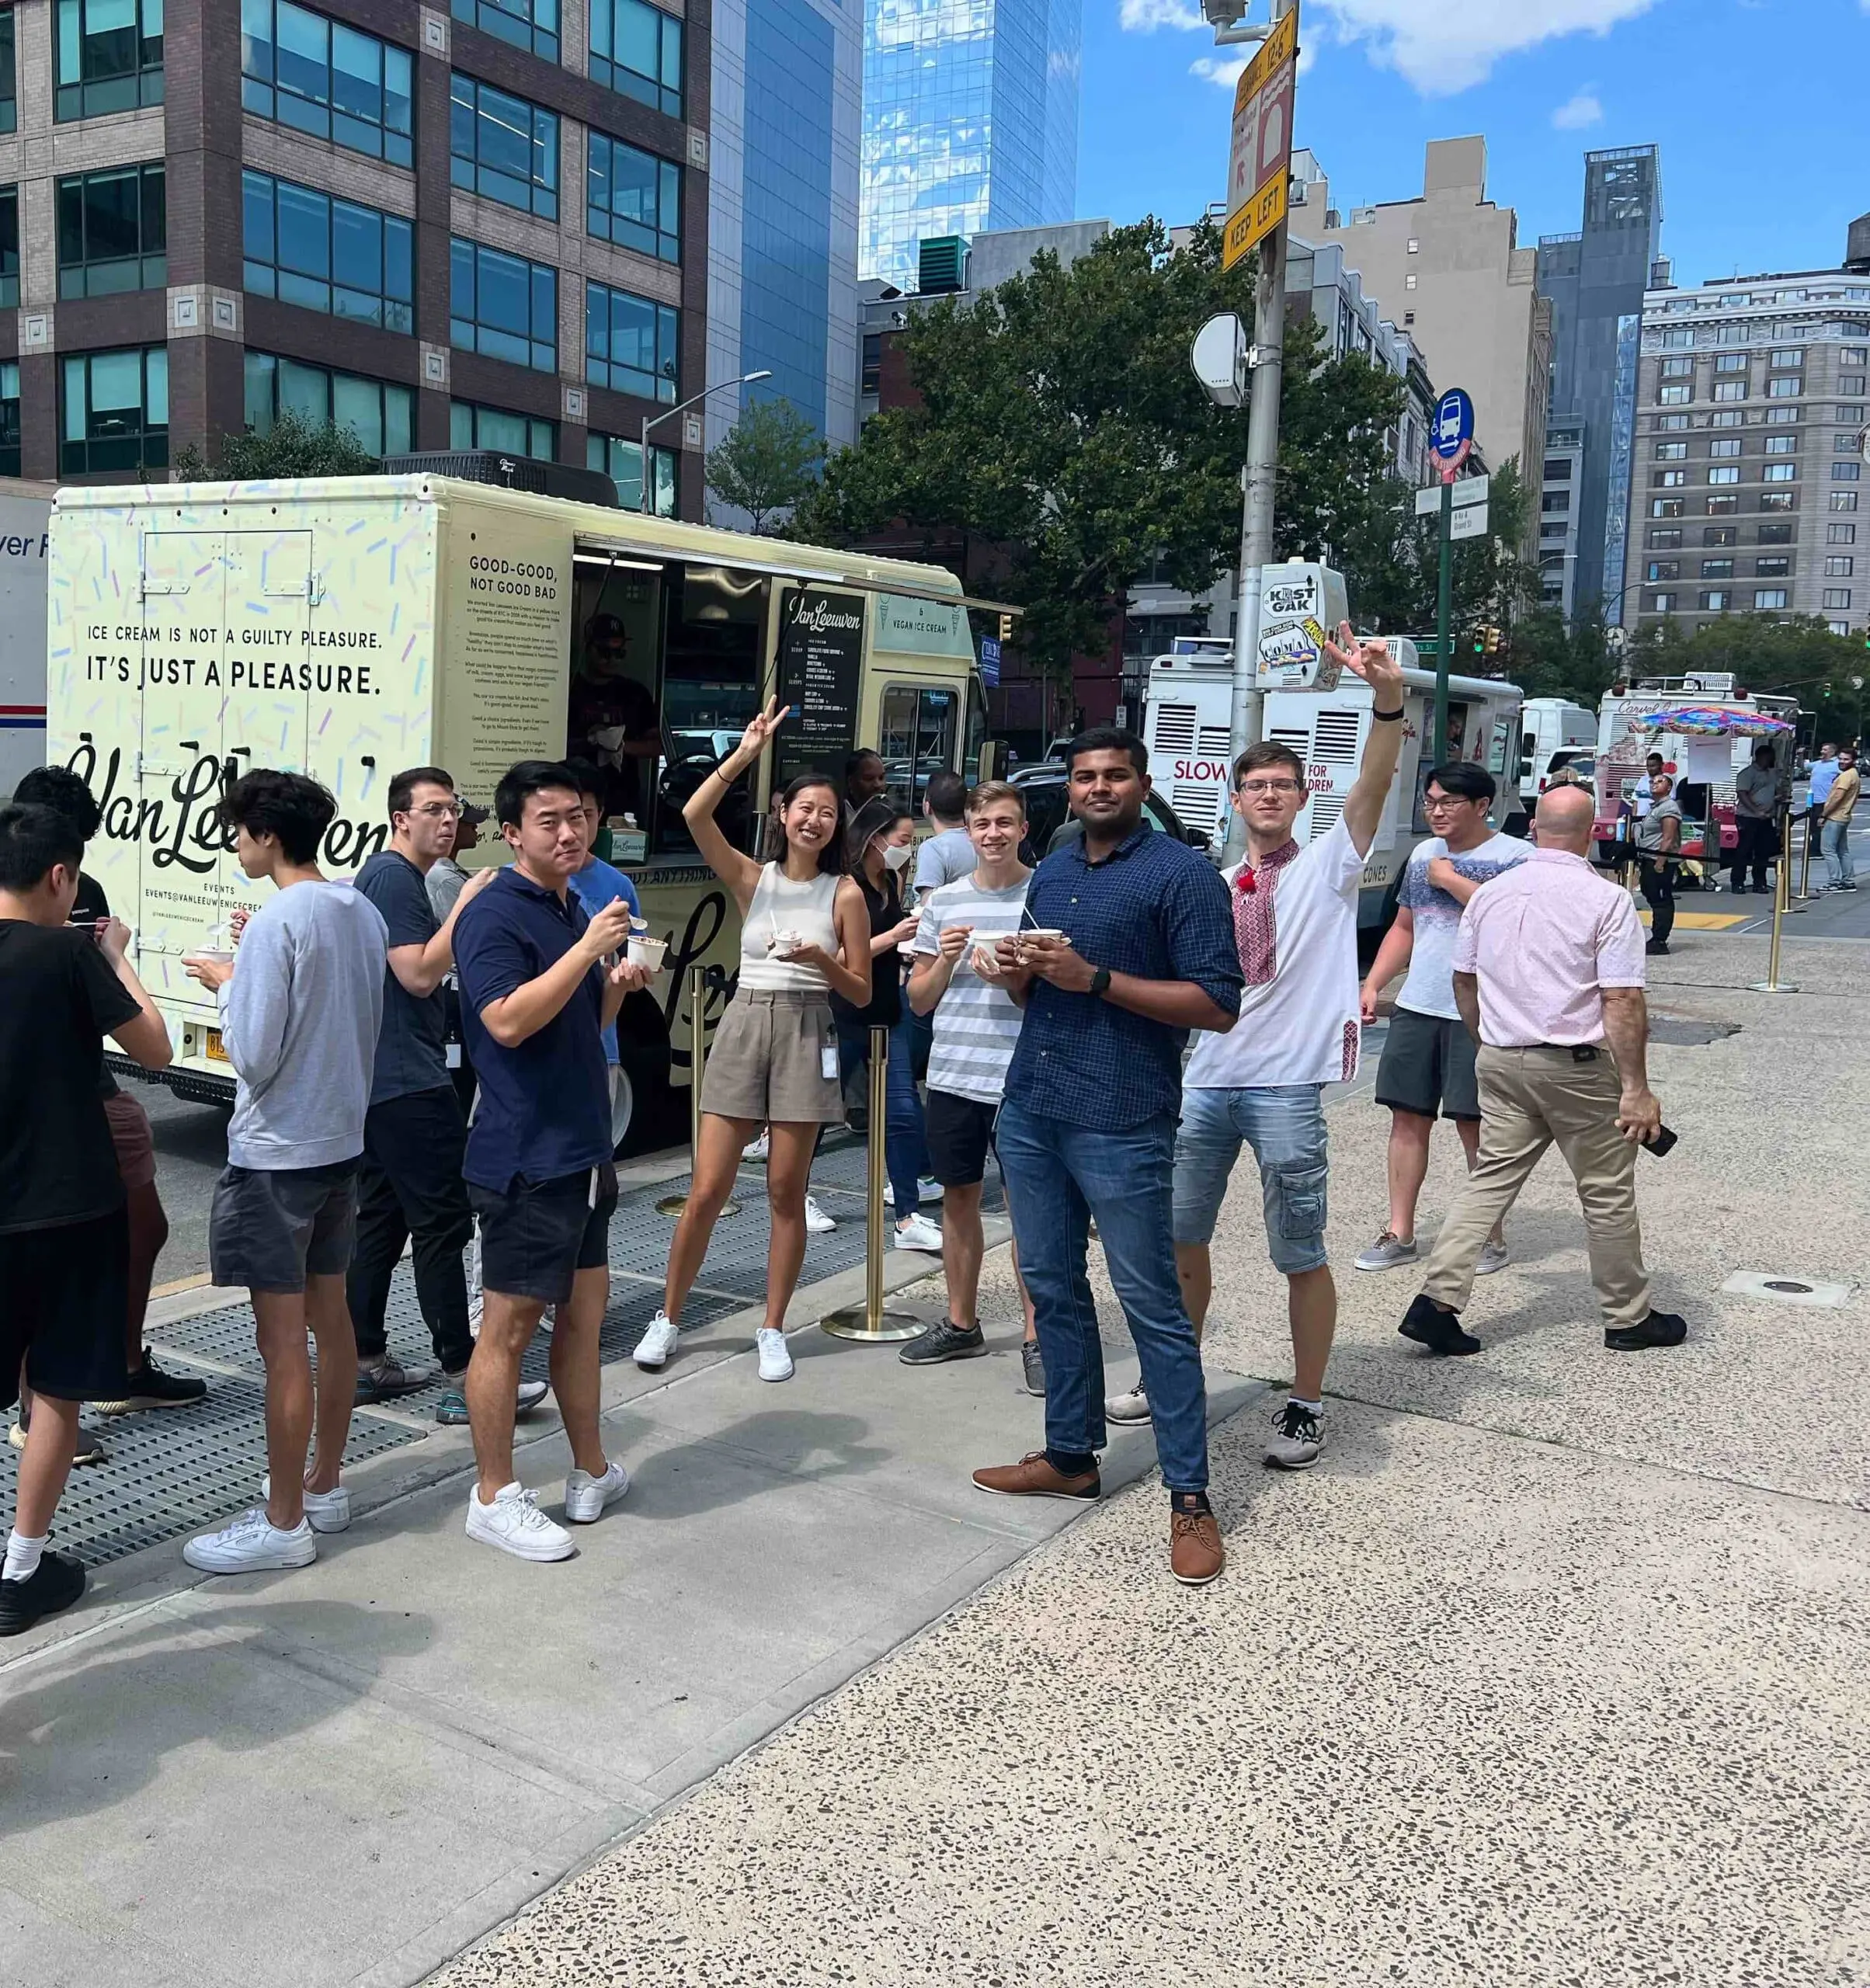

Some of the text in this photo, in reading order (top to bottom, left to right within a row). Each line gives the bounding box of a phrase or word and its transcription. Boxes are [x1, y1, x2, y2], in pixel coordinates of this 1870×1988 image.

[1229, 185, 1279, 253] KEEP LEFT
[470, 555, 557, 584] GOOD-GOOD,
[471, 577, 556, 600] NOT GOOD BAD
[809, 600, 860, 633] Leeuwen
[1272, 600, 1309, 613] GAK
[88, 625, 383, 649] ICE CREAM IS NOT A GUILTY PLEASURE.
[893, 620, 947, 634] VEGAN ICE CREAM
[1265, 641, 1303, 658] COMA
[87, 655, 381, 696] IT'S JUST A PLEASURE.
[1174, 760, 1227, 783] SLOW
[1309, 764, 1326, 777] FOR
[650, 868, 717, 885] ANYTHING
[1363, 865, 1387, 884] CONES
[203, 883, 235, 895] EVENTS
